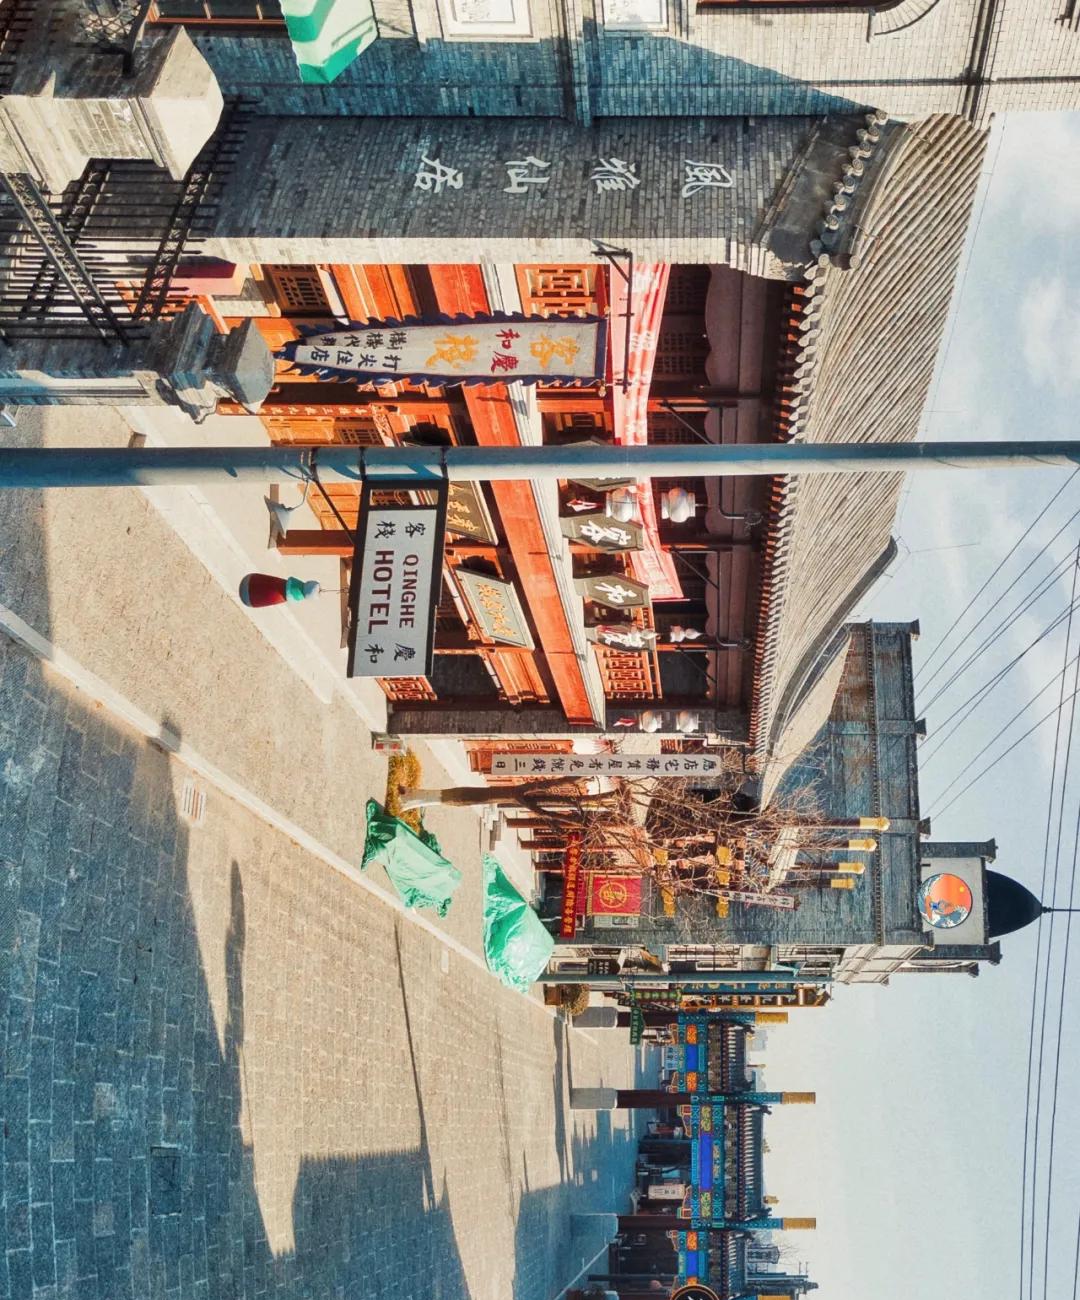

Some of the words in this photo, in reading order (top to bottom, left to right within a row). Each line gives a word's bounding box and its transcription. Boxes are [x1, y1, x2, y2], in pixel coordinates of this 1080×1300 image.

[413, 154, 734, 198] 風雅仙居
[310, 345, 402, 372] 打尖住店
[373, 520, 427, 539] 客棧
[579, 520, 632, 546] 客
[367, 550, 395, 635] HOTEL
[398, 553, 420, 629] QINGHE
[594, 582, 638, 604] 和
[364, 642, 417, 664] 慶和
